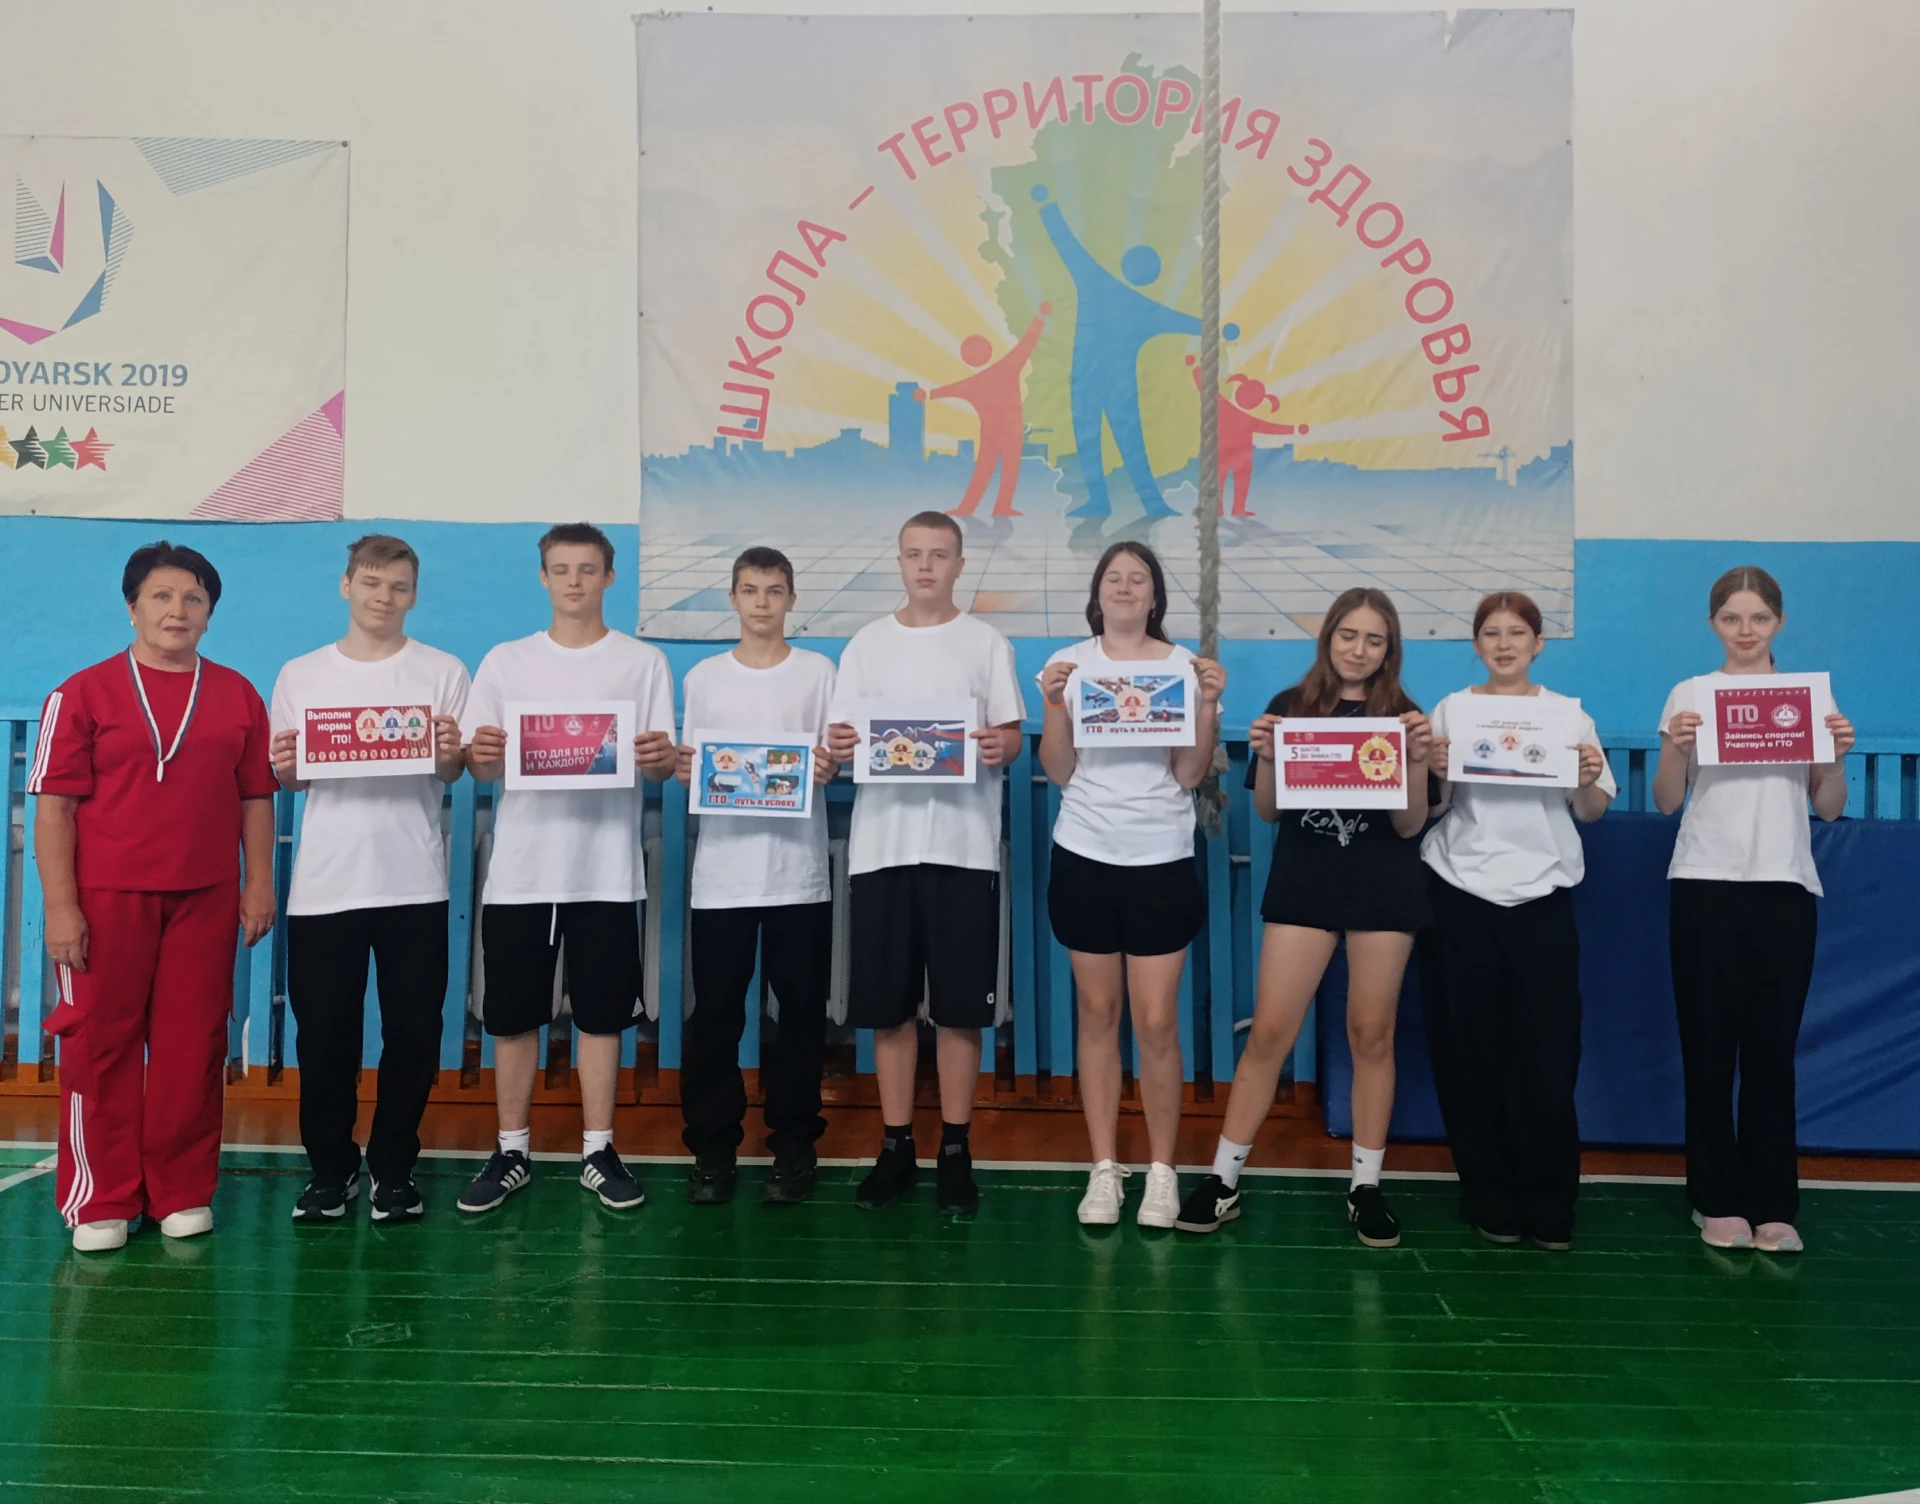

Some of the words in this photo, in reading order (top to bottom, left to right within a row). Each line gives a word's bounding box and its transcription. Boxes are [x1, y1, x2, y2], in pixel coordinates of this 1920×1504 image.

[716, 219, 847, 441] ШКОЛА
[877, 74, 1281, 181] ТЕРРИТОРИЯ
[1286, 138, 1491, 442] ЗДОРОВЬЯ
[121, 363, 188, 387] 2019
[33, 394, 175, 414] UNIVERSIADE
[307, 711, 351, 721] Выполни
[317, 722, 351, 733] нормы
[331, 734, 351, 744] ГТО!
[1724, 732, 1763, 740] Займись
[1765, 731, 1805, 740] спортом!
[1724, 740, 1766, 749] Участвуй
[525, 750, 547, 760] ГТО
[549, 748, 570, 759] ДЛЯ
[573, 746, 596, 756] ВСЕХ
[1291, 746, 1298, 760] 5
[526, 762, 534, 771] И
[708, 794, 727, 804] ГТО
[734, 798, 755, 806] путь
[765, 799, 796, 808] успеху
